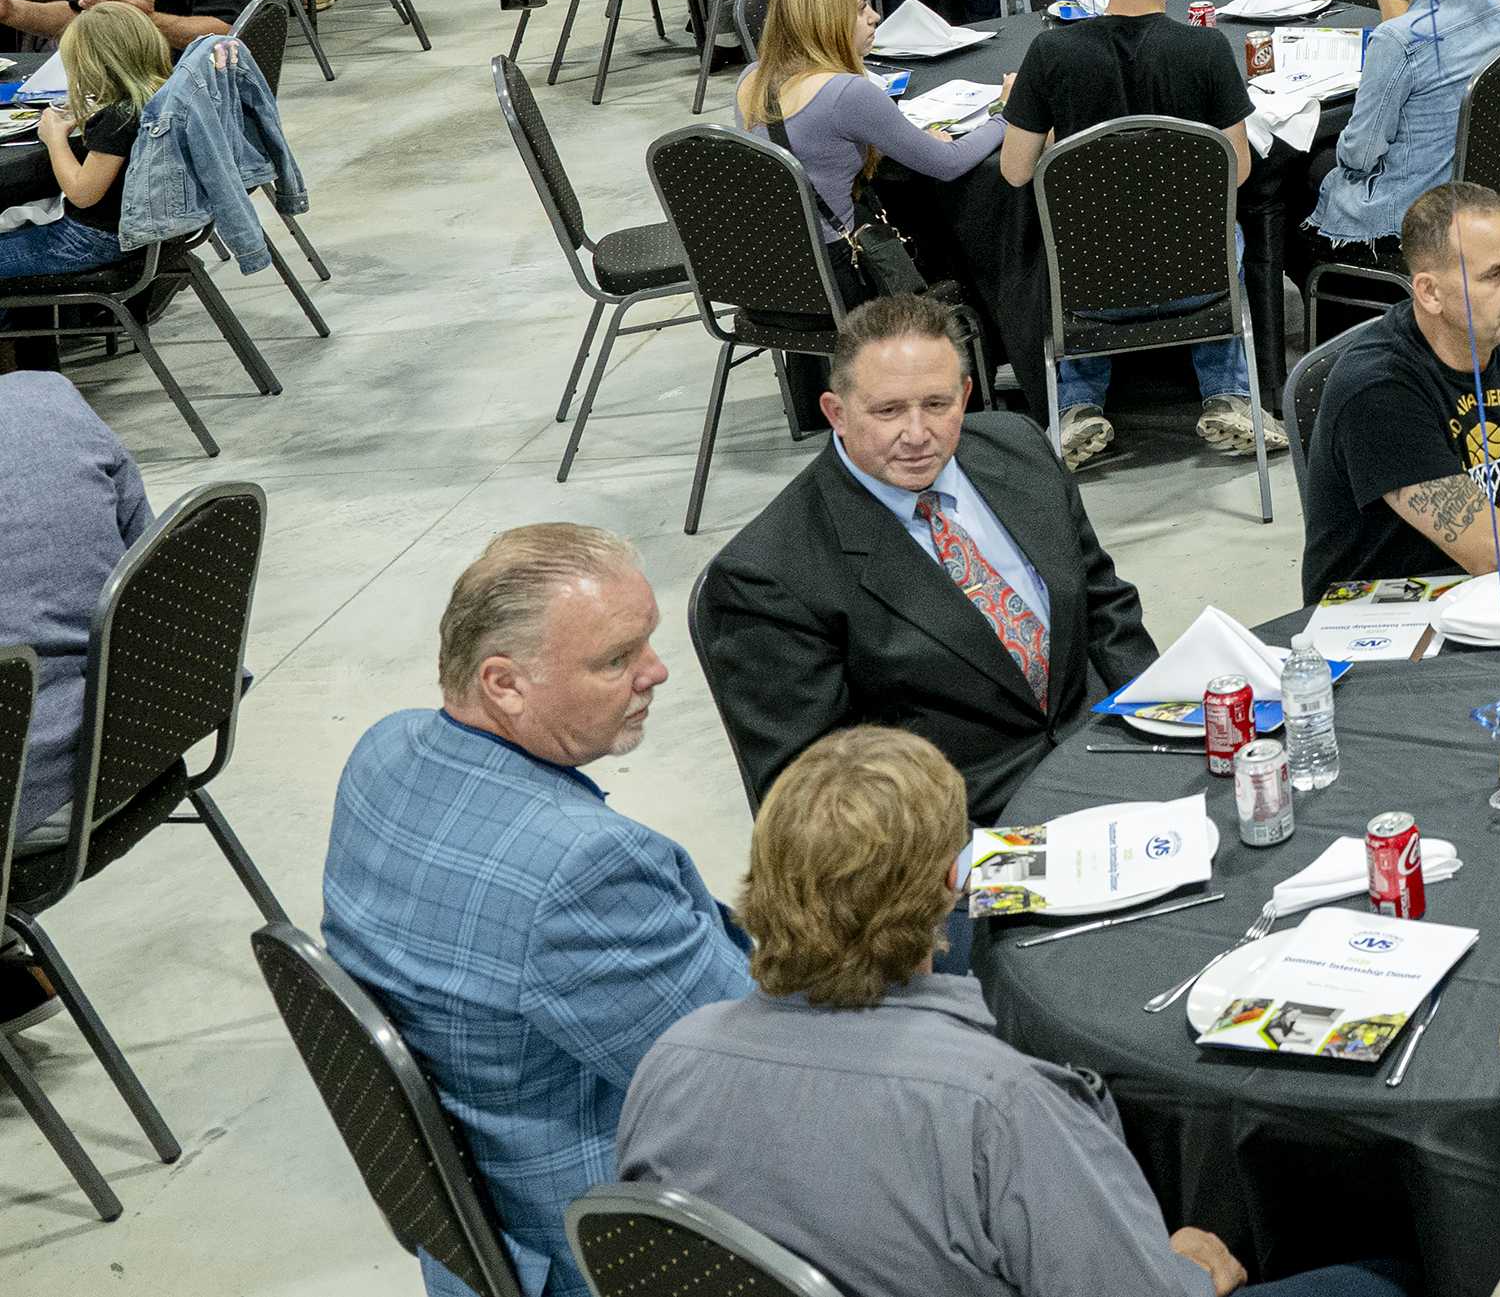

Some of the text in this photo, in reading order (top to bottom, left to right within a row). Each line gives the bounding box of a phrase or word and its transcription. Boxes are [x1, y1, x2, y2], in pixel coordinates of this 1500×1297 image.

[1153, 837, 1171, 856] JVS
[1353, 937, 1394, 950] JVS
[1283, 956, 1422, 980] Summer Internship Dinner
